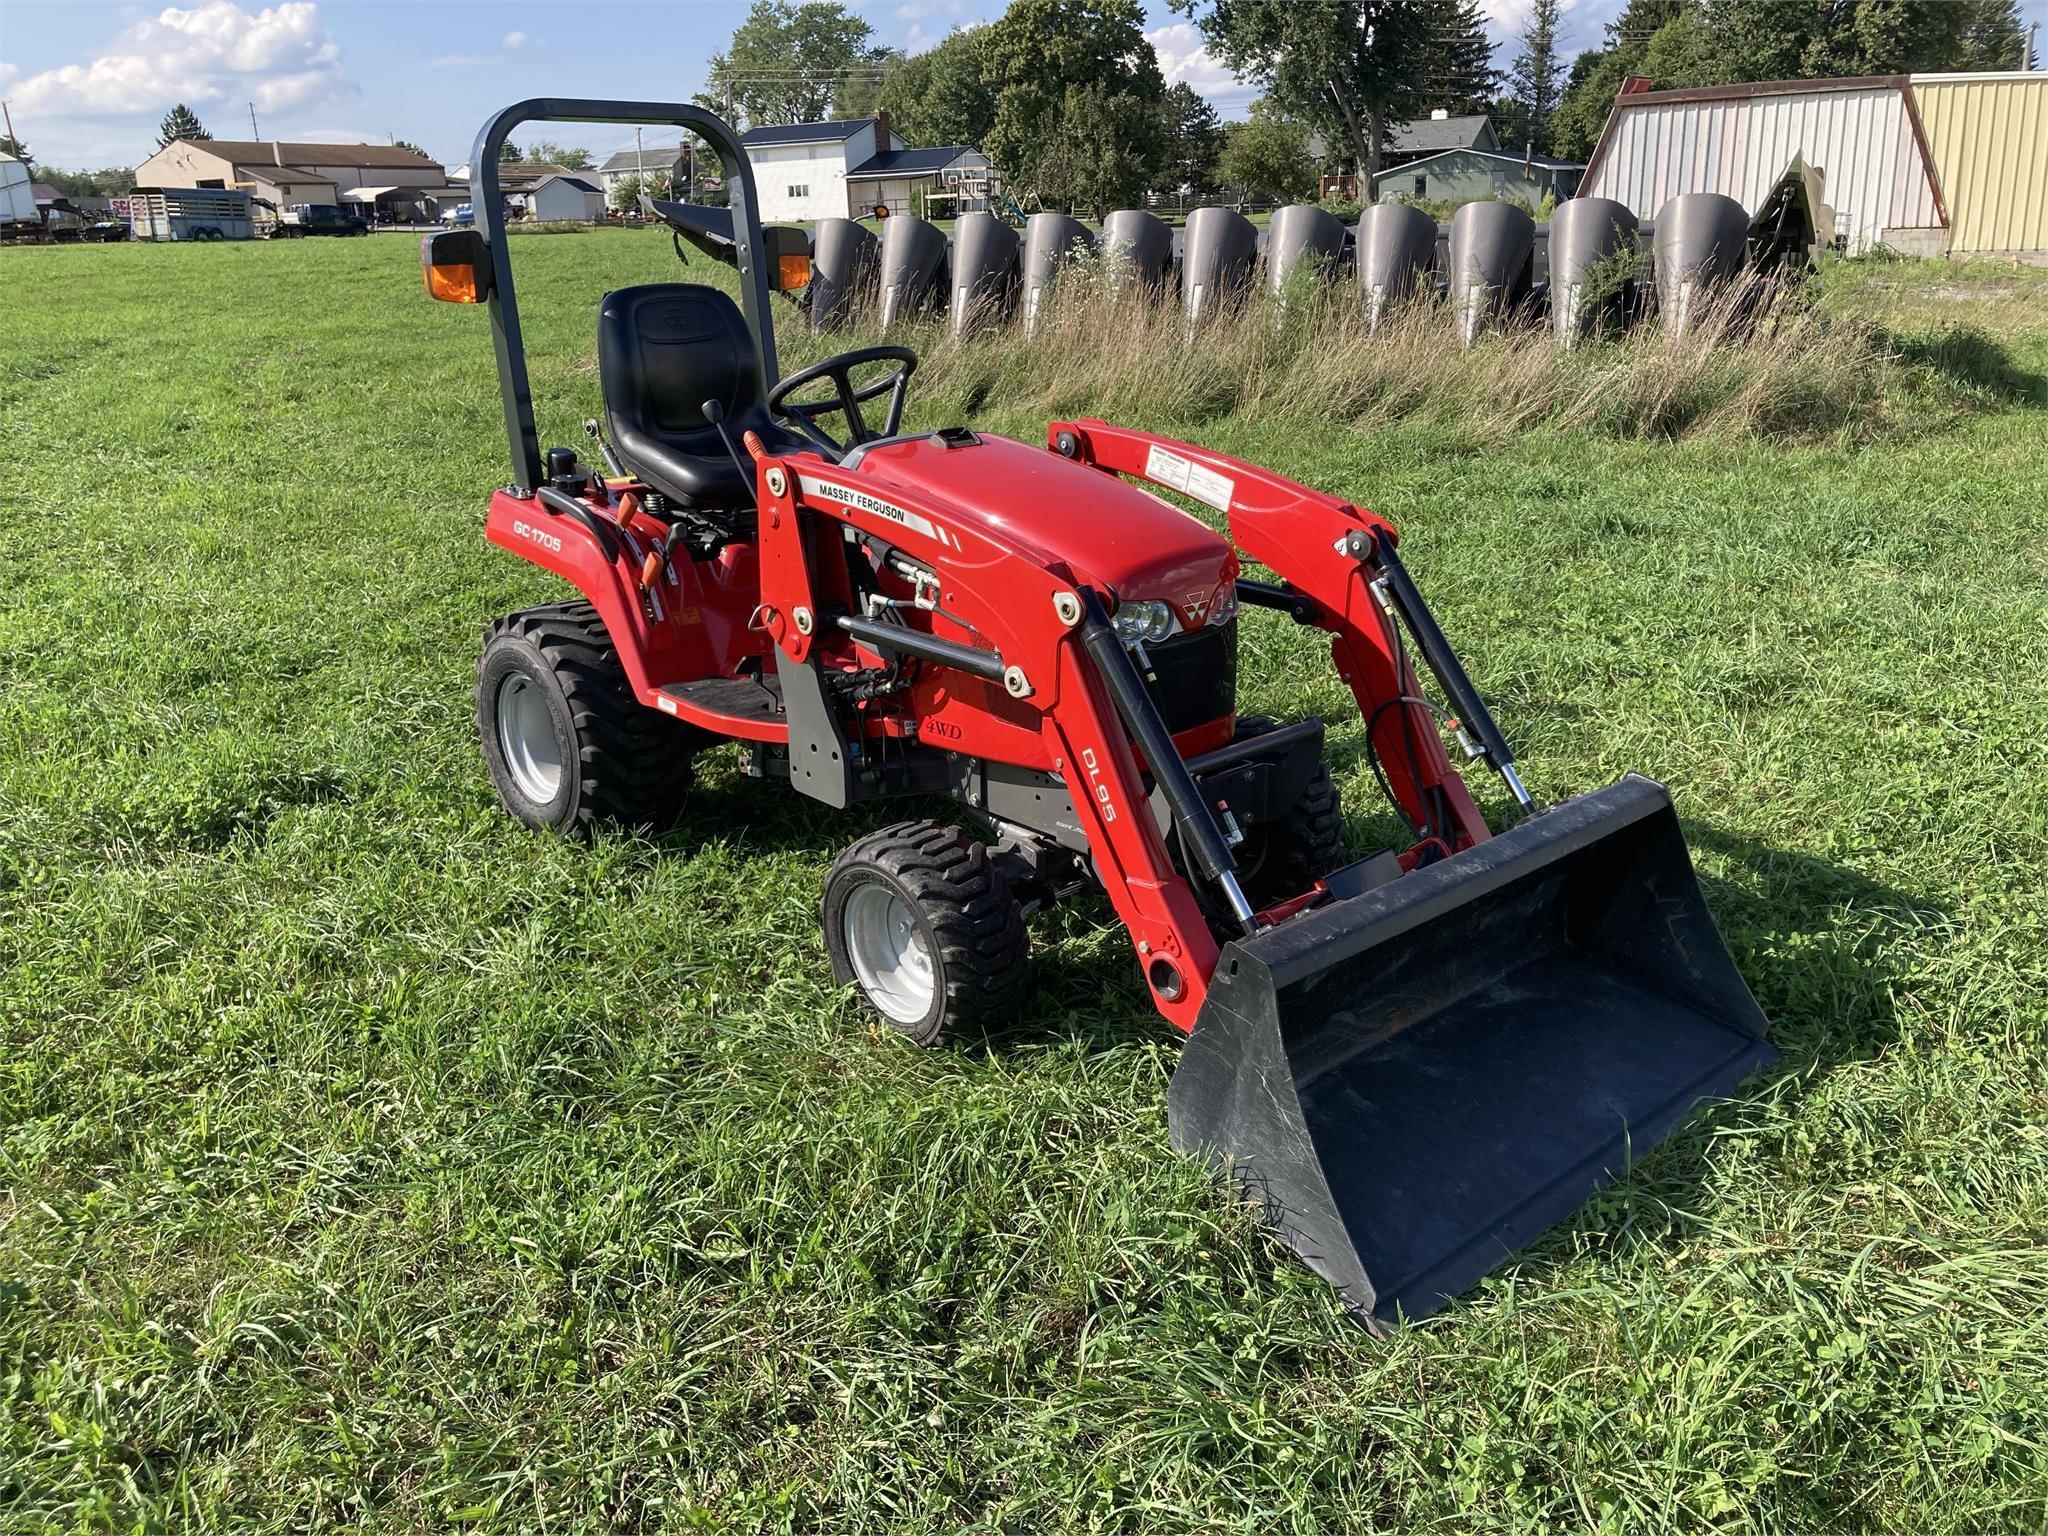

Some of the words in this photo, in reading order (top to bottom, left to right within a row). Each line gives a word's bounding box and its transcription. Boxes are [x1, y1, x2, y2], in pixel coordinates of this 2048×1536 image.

[819, 484, 855, 503] MASSEY
[857, 495, 905, 522] FERGUSON
[926, 719, 962, 739] 4WD
[1082, 747, 1117, 822] DL95
